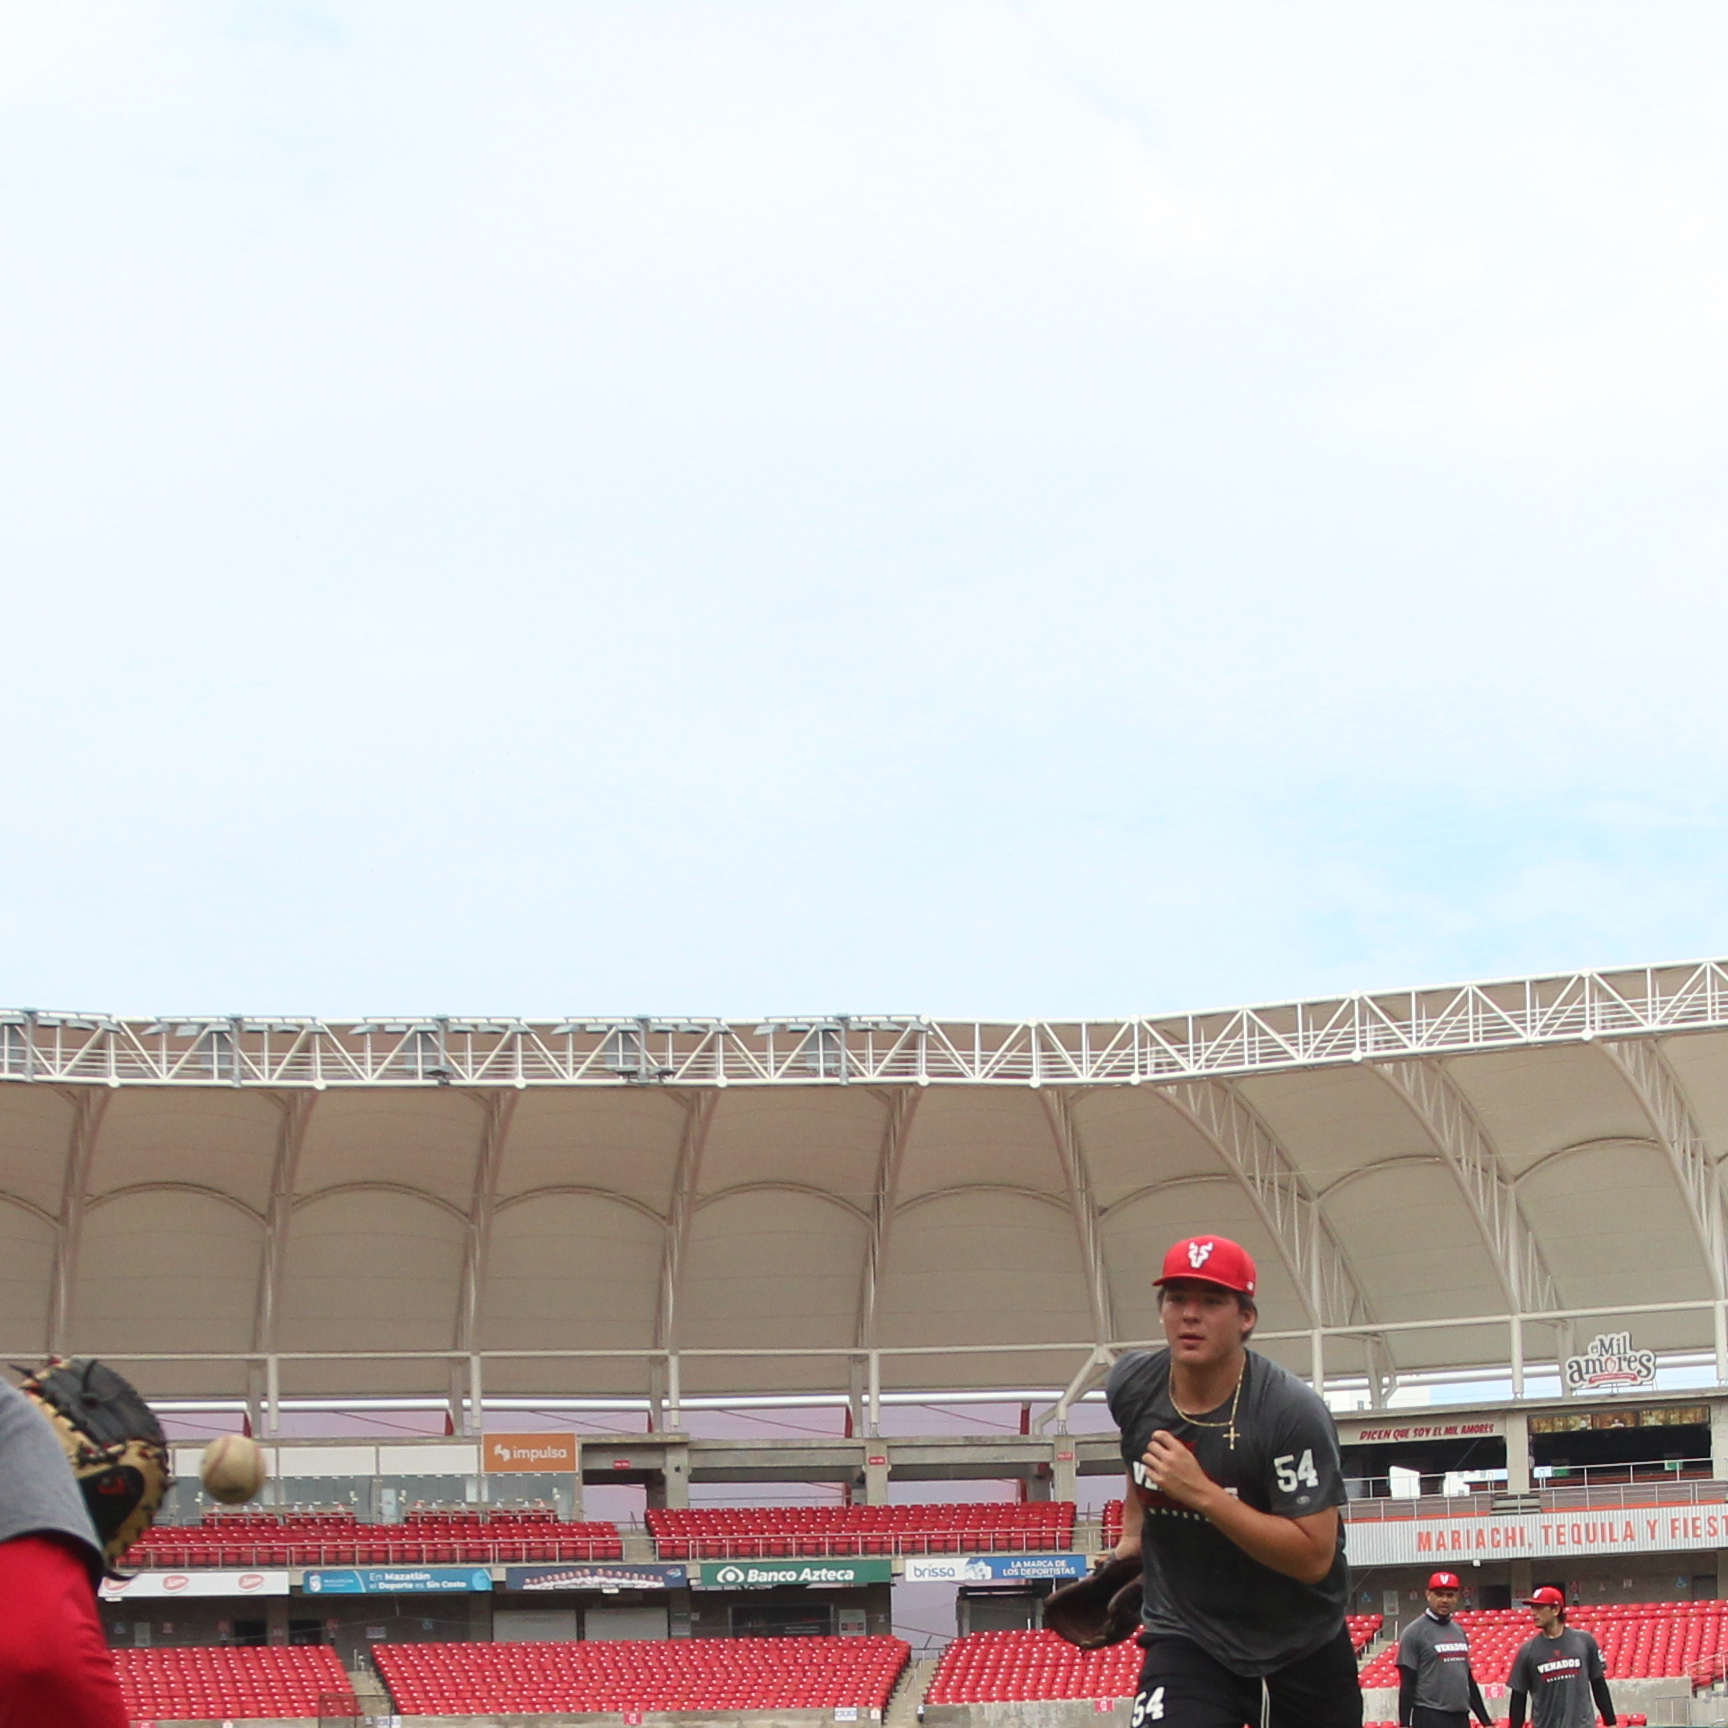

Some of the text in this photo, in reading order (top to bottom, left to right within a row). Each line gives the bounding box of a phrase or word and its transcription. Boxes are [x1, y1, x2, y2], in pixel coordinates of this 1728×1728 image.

[1598, 1335, 1628, 1357] Mil
[1359, 1423, 1495, 1441] DICEN QUE SOY EL MIL AMORES
[1274, 1449, 1320, 1493] 54
[1418, 1526, 1534, 1551] MARIACHI,
[1542, 1520, 1636, 1546] TEQUILA
[1647, 1519, 1659, 1540] Y
[913, 1565, 956, 1577] brissa
[1021, 1567, 1076, 1576] DEPORTISTAS
[1024, 1560, 1053, 1568] MARCA
[369, 1573, 383, 1581] En
[747, 1567, 855, 1582] Banco Azteca
[378, 1582, 414, 1591] Deporte
[426, 1580, 440, 1589] Sin
[1537, 1658, 1581, 1674] VENADOS
[1131, 1686, 1165, 1728] 54
